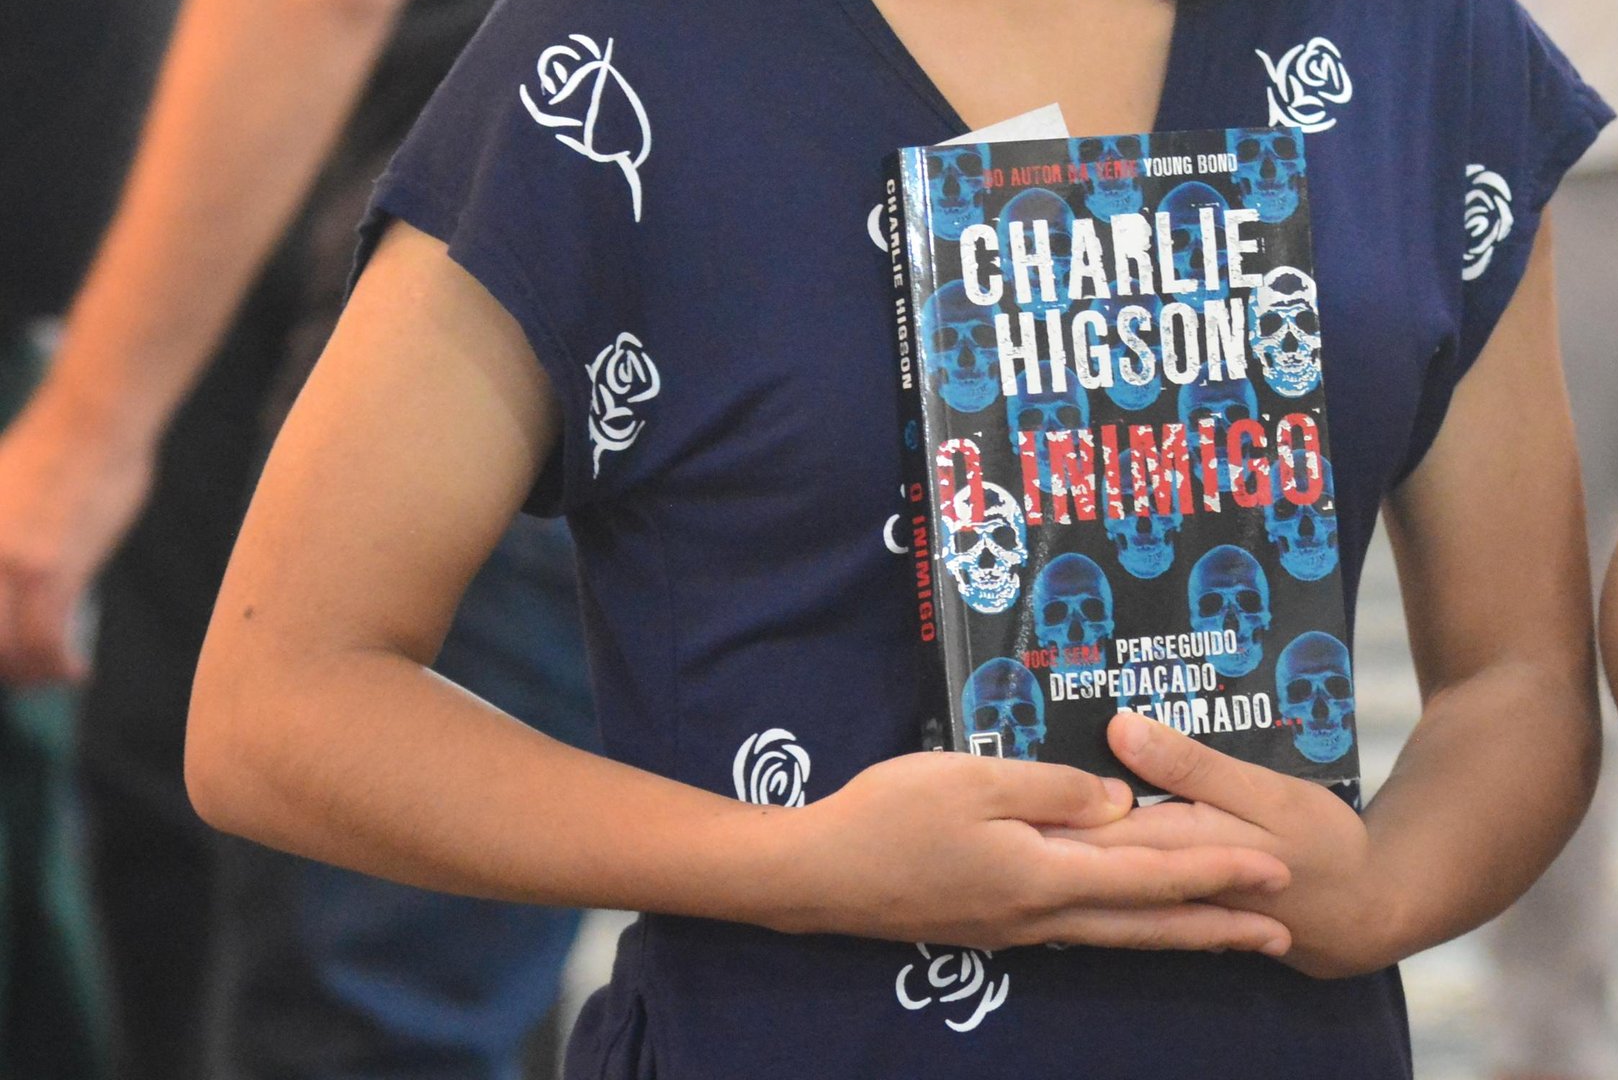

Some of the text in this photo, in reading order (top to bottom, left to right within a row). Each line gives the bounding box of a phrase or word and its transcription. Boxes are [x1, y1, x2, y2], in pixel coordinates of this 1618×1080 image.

[1011, 164, 1062, 186] AUTOR
[1143, 156, 1193, 177] YOUNG
[1197, 153, 1239, 175] BOND
[886, 179, 913, 390] CHARLIE HIGSON
[959, 208, 1264, 306] CHARLIE
[994, 298, 1249, 396] HIGSON
[936, 413, 1324, 532] O INIMIGO
[910, 482, 935, 642] O INIMIGO
[1023, 647, 1057, 668] VOCÊ
